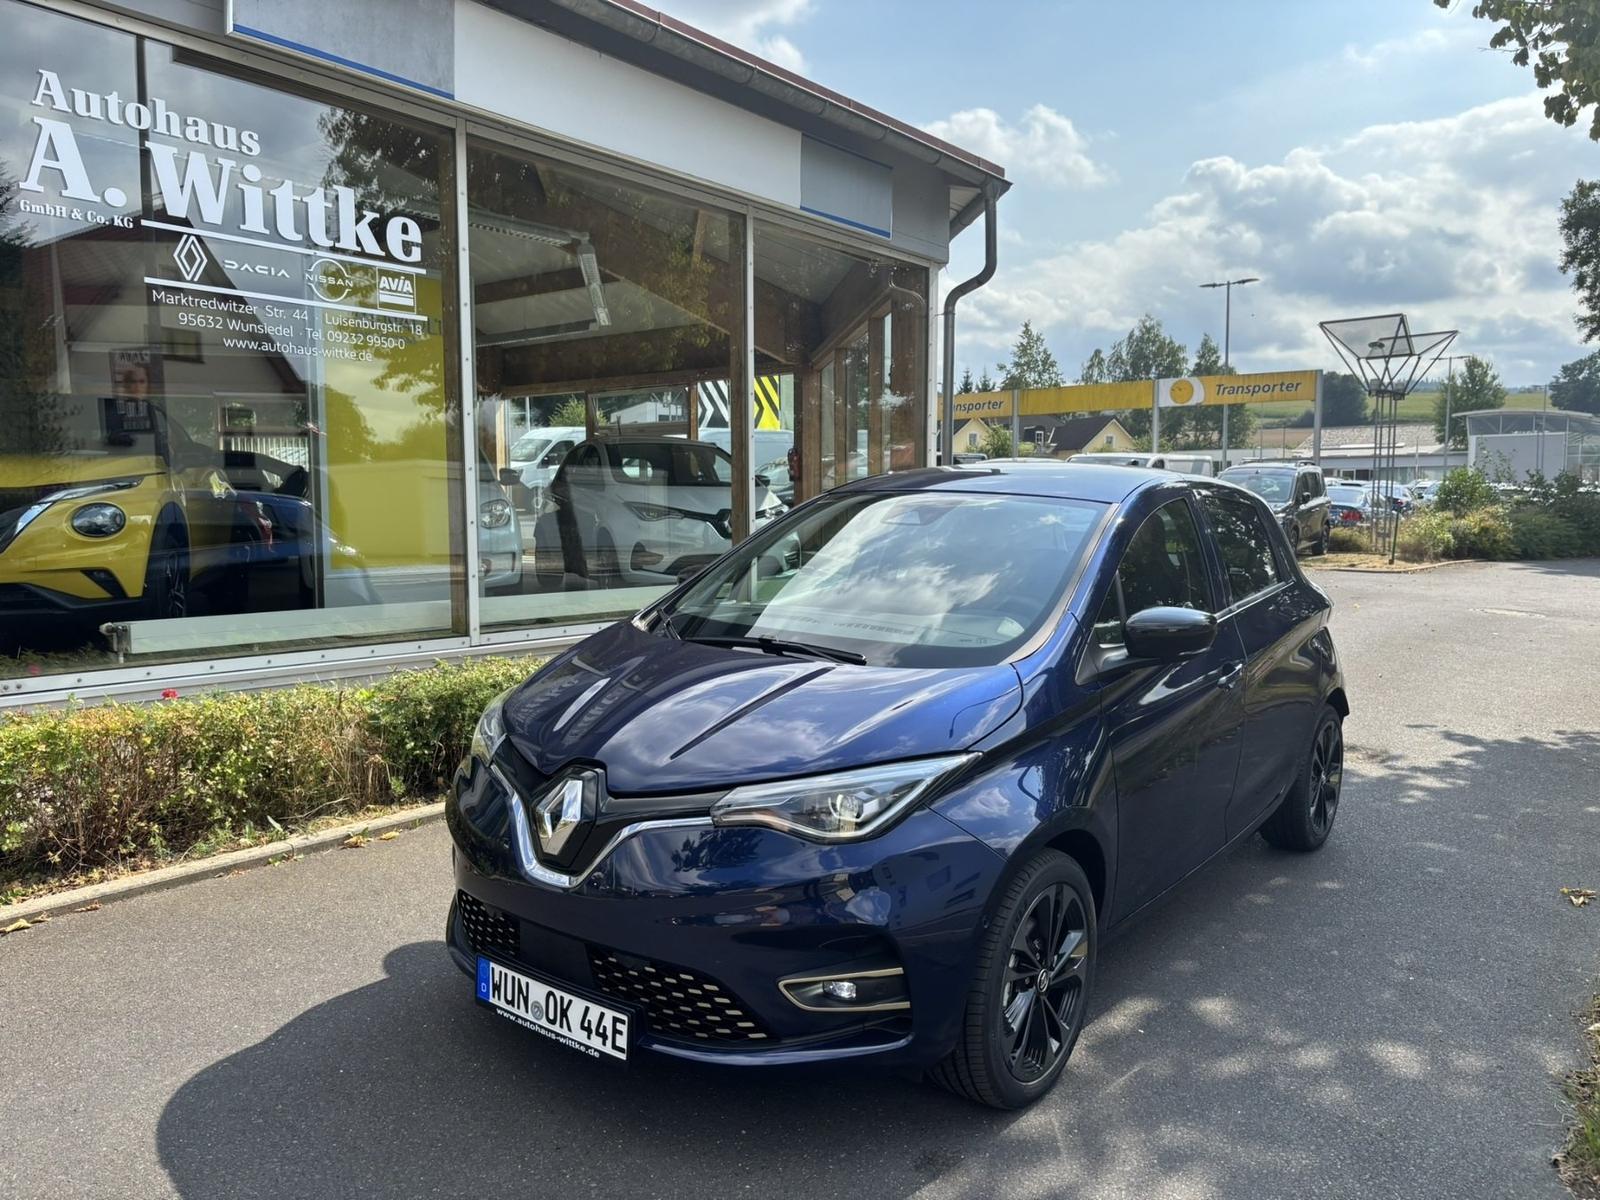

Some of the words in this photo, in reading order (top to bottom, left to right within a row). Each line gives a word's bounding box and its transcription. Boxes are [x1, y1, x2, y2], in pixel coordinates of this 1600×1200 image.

[32, 68, 261, 156] Autohaus
[18, 115, 127, 208] A.
[145, 140, 423, 263] Wittke
[20, 199, 68, 219] GmbH
[71, 207, 83, 221] &
[87, 210, 110, 226] Co.
[113, 214, 135, 230] KG
[223, 259, 291, 279] DACIA
[305, 272, 354, 288] NISSAN
[379, 275, 414, 294] AVIA
[152, 289, 259, 316] Marktredwitzer
[265, 304, 287, 320] Str.
[292, 308, 309, 321] 44
[325, 311, 404, 335] Luisenburgstr.
[178, 312, 224, 330] 95632
[226, 317, 294, 338] Wunsiedel
[305, 326, 325, 342] Tel.
[327, 330, 365, 346] 09232
[366, 334, 406, 350] 9950-0
[223, 337, 373, 362] www.autohaus-wittke.de
[1214, 380, 1302, 397] Transporter
[953, 399, 1005, 414] nsporter
[481, 982, 487, 993] D
[490, 966, 530, 1015] WUN
[544, 990, 573, 1033] OK
[580, 1005, 626, 1055] 44E
[496, 1007, 600, 1059] www.autohaus-wittke.de
